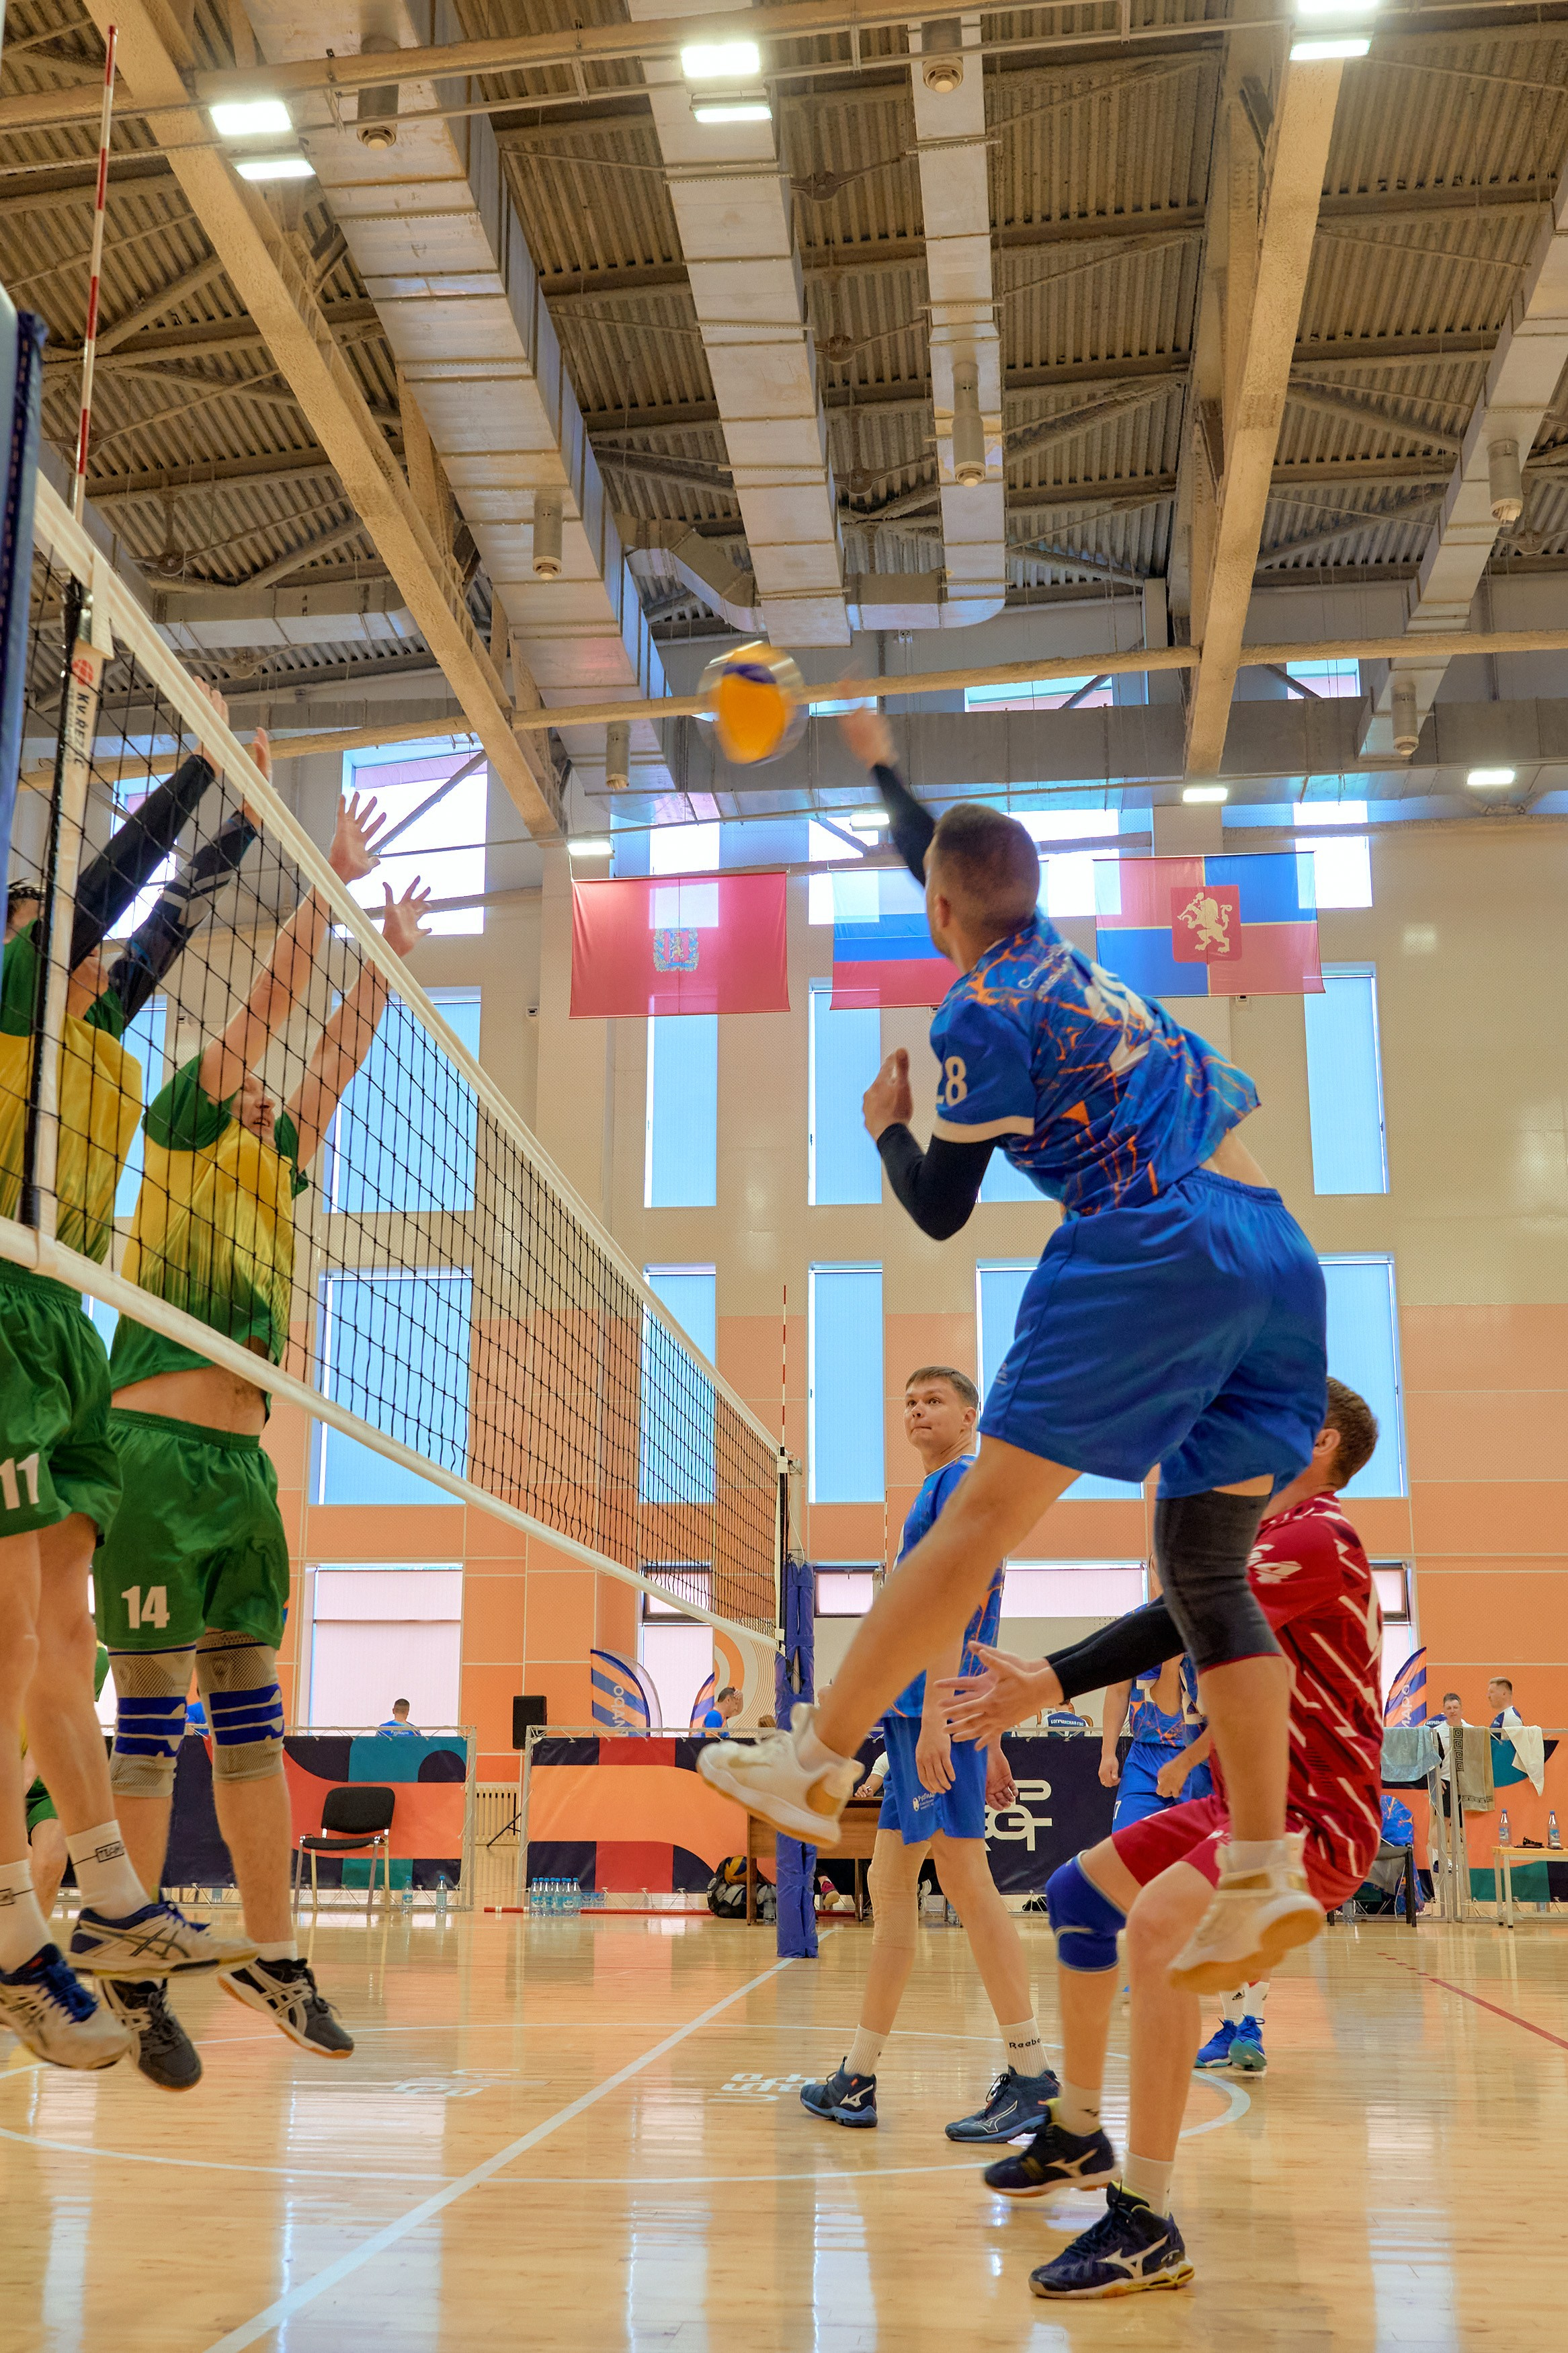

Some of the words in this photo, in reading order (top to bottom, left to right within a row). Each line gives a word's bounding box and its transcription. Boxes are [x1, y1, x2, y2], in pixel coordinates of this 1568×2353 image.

[937, 1055, 968, 1107] 8
[0, 1452, 40, 1511] 11
[120, 1585, 171, 1629] 14
